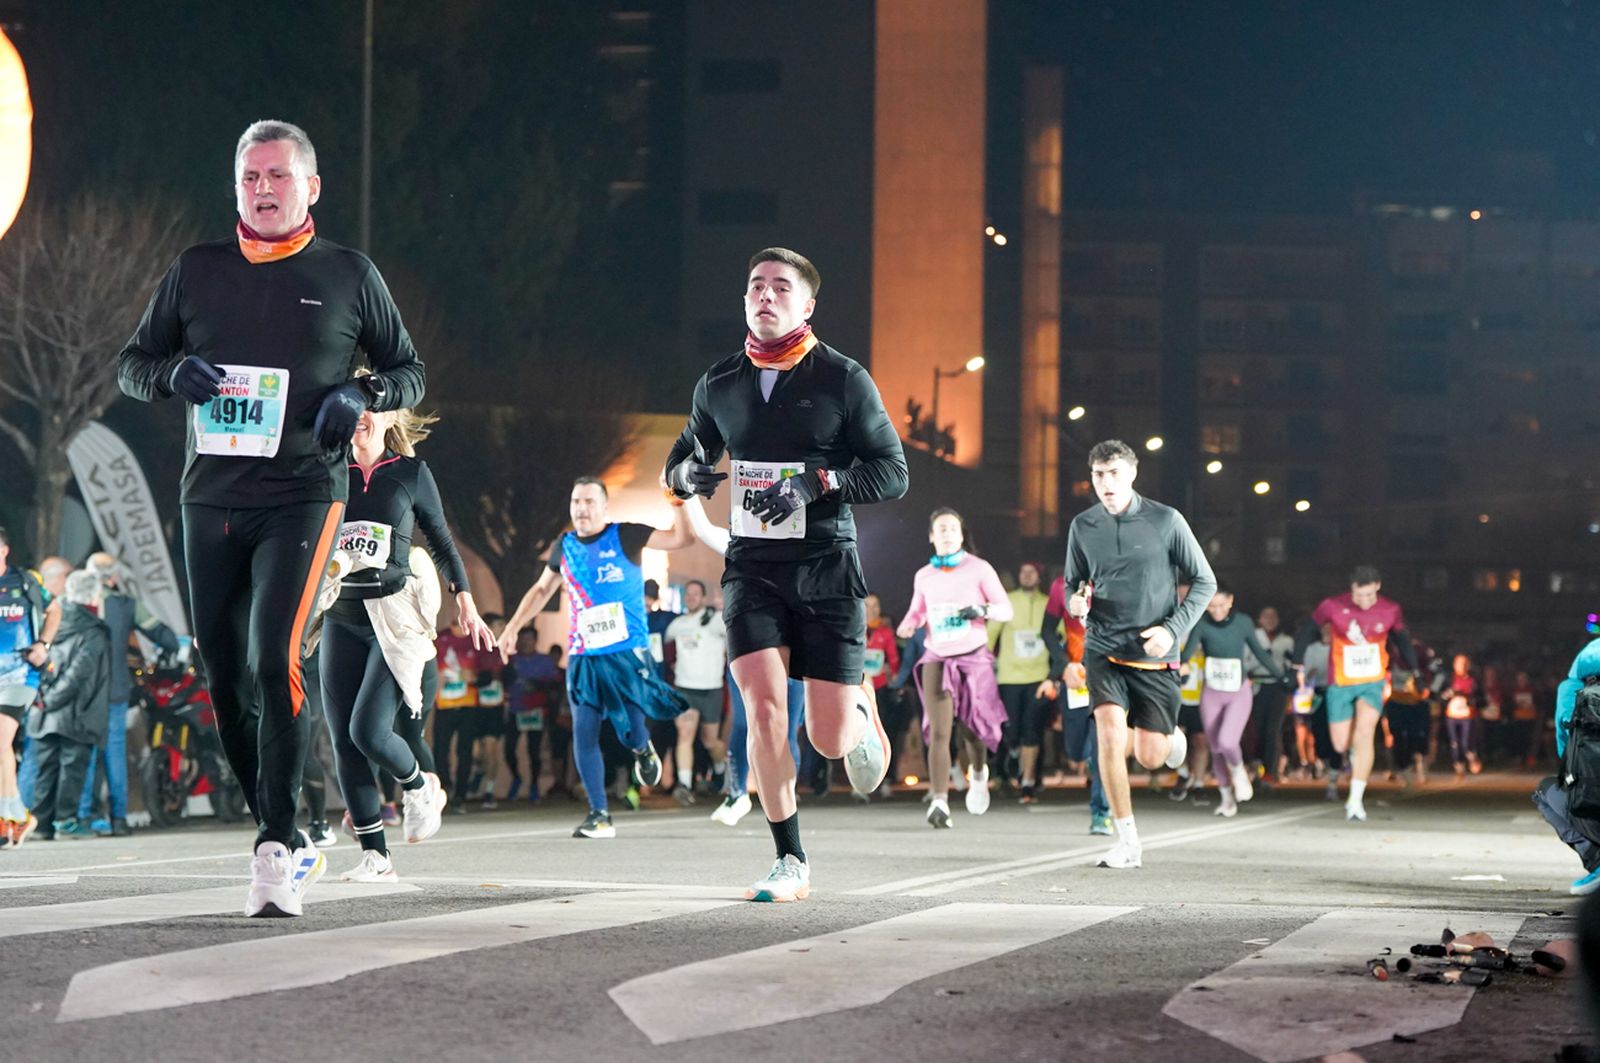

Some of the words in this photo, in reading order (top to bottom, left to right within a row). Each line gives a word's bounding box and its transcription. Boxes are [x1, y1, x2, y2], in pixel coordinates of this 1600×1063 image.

[239, 376, 250, 386] DE
[210, 398, 263, 425] 4914
[763, 470, 774, 480] DE
[109, 453, 174, 595] JAPEMASA
